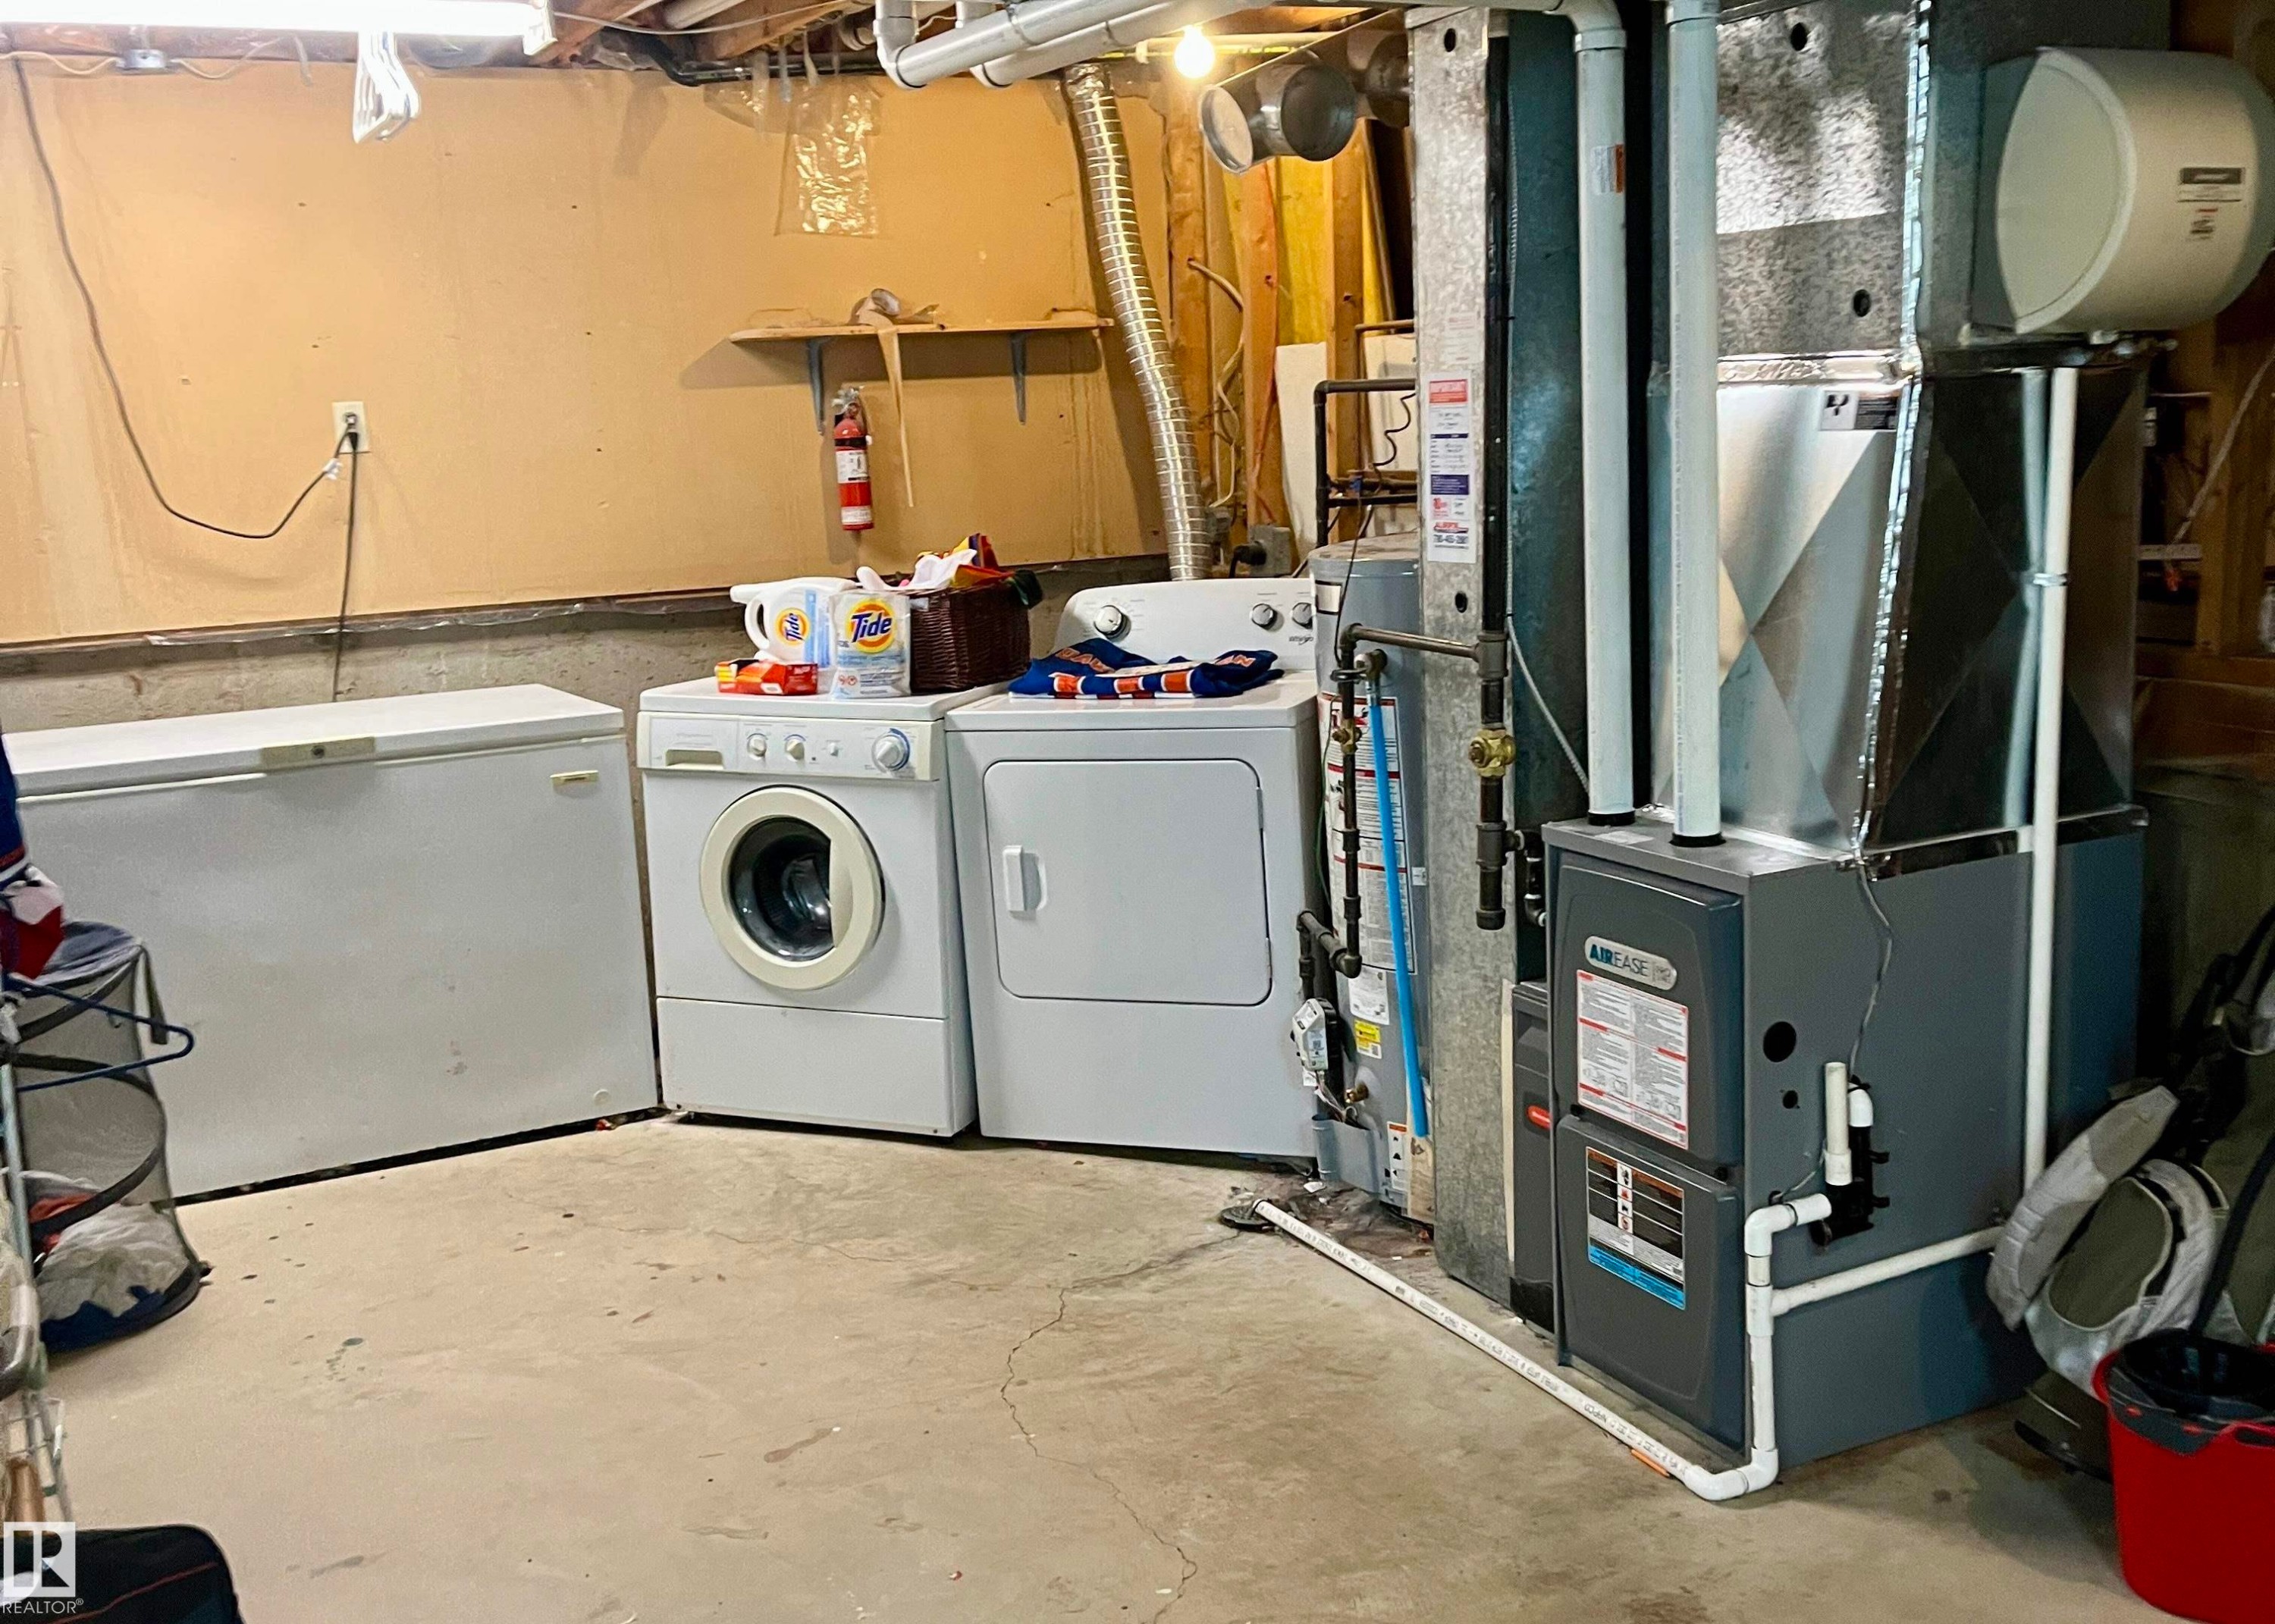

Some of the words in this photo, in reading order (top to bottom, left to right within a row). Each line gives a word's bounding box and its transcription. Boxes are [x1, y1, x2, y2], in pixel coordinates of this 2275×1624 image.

[784, 613, 804, 642] Tide
[851, 612, 893, 643] Tide
[1589, 944, 1649, 977] AIREASE
